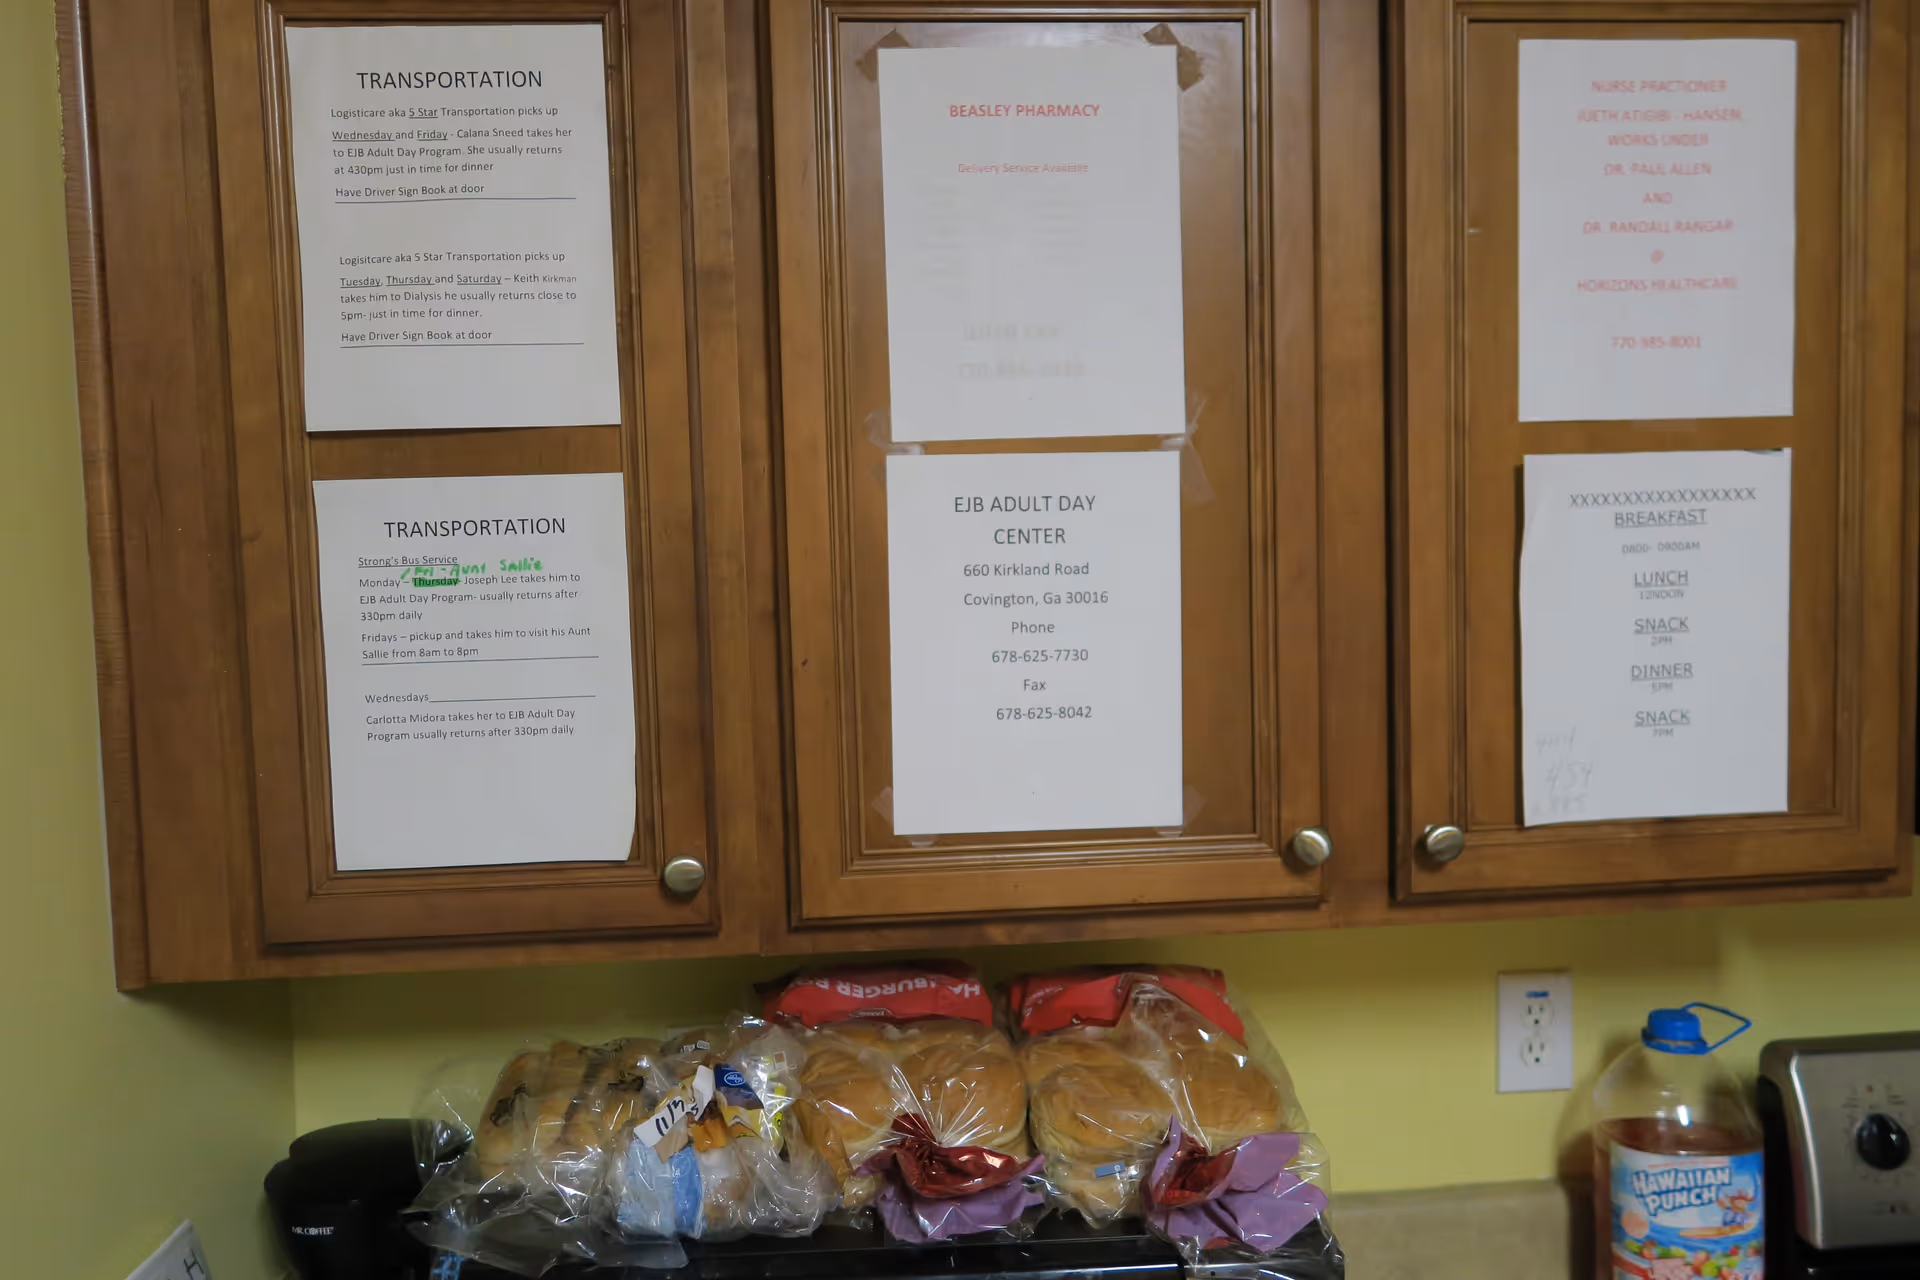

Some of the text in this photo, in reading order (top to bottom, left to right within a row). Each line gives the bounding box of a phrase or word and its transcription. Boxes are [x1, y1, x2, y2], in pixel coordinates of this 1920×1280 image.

[355, 70, 541, 89] TRANSPORTATION
[388, 107, 405, 117] aka
[408, 107, 415, 119] 5
[417, 107, 437, 119] Star
[440, 106, 515, 118] Transportation
[517, 105, 542, 117] picks
[545, 107, 558, 117] up
[949, 104, 1099, 118] BEASLEY PHARMACY
[331, 127, 572, 142] Wednesday and Friday Calana Sneed takes her
[333, 148, 344, 157] to
[347, 147, 364, 158] EJB
[366, 147, 394, 157] Adult
[397, 147, 416, 159] Day
[467, 144, 484, 155] She
[487, 144, 523, 156] usually
[526, 146, 562, 155] returns
[334, 162, 493, 176] at 430pm just in time for dinner
[335, 183, 484, 198] Have Driver Sign Book at door
[1642, 191, 1672, 205] AND
[394, 252, 411, 263] aka
[414, 252, 420, 262] 5
[423, 252, 443, 262] Star
[445, 251, 521, 263] Transportation
[524, 251, 549, 263] picks
[552, 253, 565, 262] up
[339, 273, 576, 289] Tuesday, Thursday and Saturday Keith Kirkman
[340, 290, 576, 304] takes him to Dialysis he usually returns close to
[368, 310, 387, 321] just
[389, 309, 398, 318] in
[402, 308, 425, 318] time
[428, 307, 443, 318] for
[446, 308, 482, 317] dinner.
[954, 495, 1095, 513] EJB ADULT DAY
[1614, 508, 1707, 528] BREAKFAST
[383, 517, 564, 538] TRANSPORTATION
[993, 527, 1065, 545] CENTER
[358, 554, 457, 568] Strong's Bus Service
[963, 562, 1089, 577] 660 Kirkland Road
[359, 578, 400, 589] Monday
[464, 574, 497, 585] Joseph
[501, 575, 517, 583] Lee
[520, 573, 546, 583] takes
[549, 573, 568, 582] him
[570, 573, 580, 581] to
[1634, 570, 1688, 588] LUNCH
[359, 595, 376, 605] EJB
[379, 594, 406, 604] Adult
[409, 593, 428, 604] Day
[479, 590, 513, 602] usually
[516, 591, 552, 600] returns
[554, 588, 578, 599] after
[963, 590, 1108, 607] Covington, Ga 30016
[360, 610, 422, 622] 330pm daily
[1011, 620, 1055, 633] Phone
[1634, 616, 1689, 633] SNACK
[361, 626, 590, 644] Fridays pickup and takes him to visit his Aunt
[362, 646, 478, 659] Sallie from 8am to 8pm
[991, 648, 1088, 663] 678-625-7730
[1631, 662, 1693, 681] DINNER
[1023, 678, 1046, 691] Fax
[365, 708, 575, 725] Carlotta Midora takes her to EJB Adult Day
[996, 705, 1092, 720] 678-625-8042
[1634, 709, 1690, 726] SNACK
[367, 724, 574, 743] Program usually returns after 330pm daily
[1632, 1166, 1732, 1197] HAWAIIAN
[1645, 1185, 1719, 1216] PUNCH
